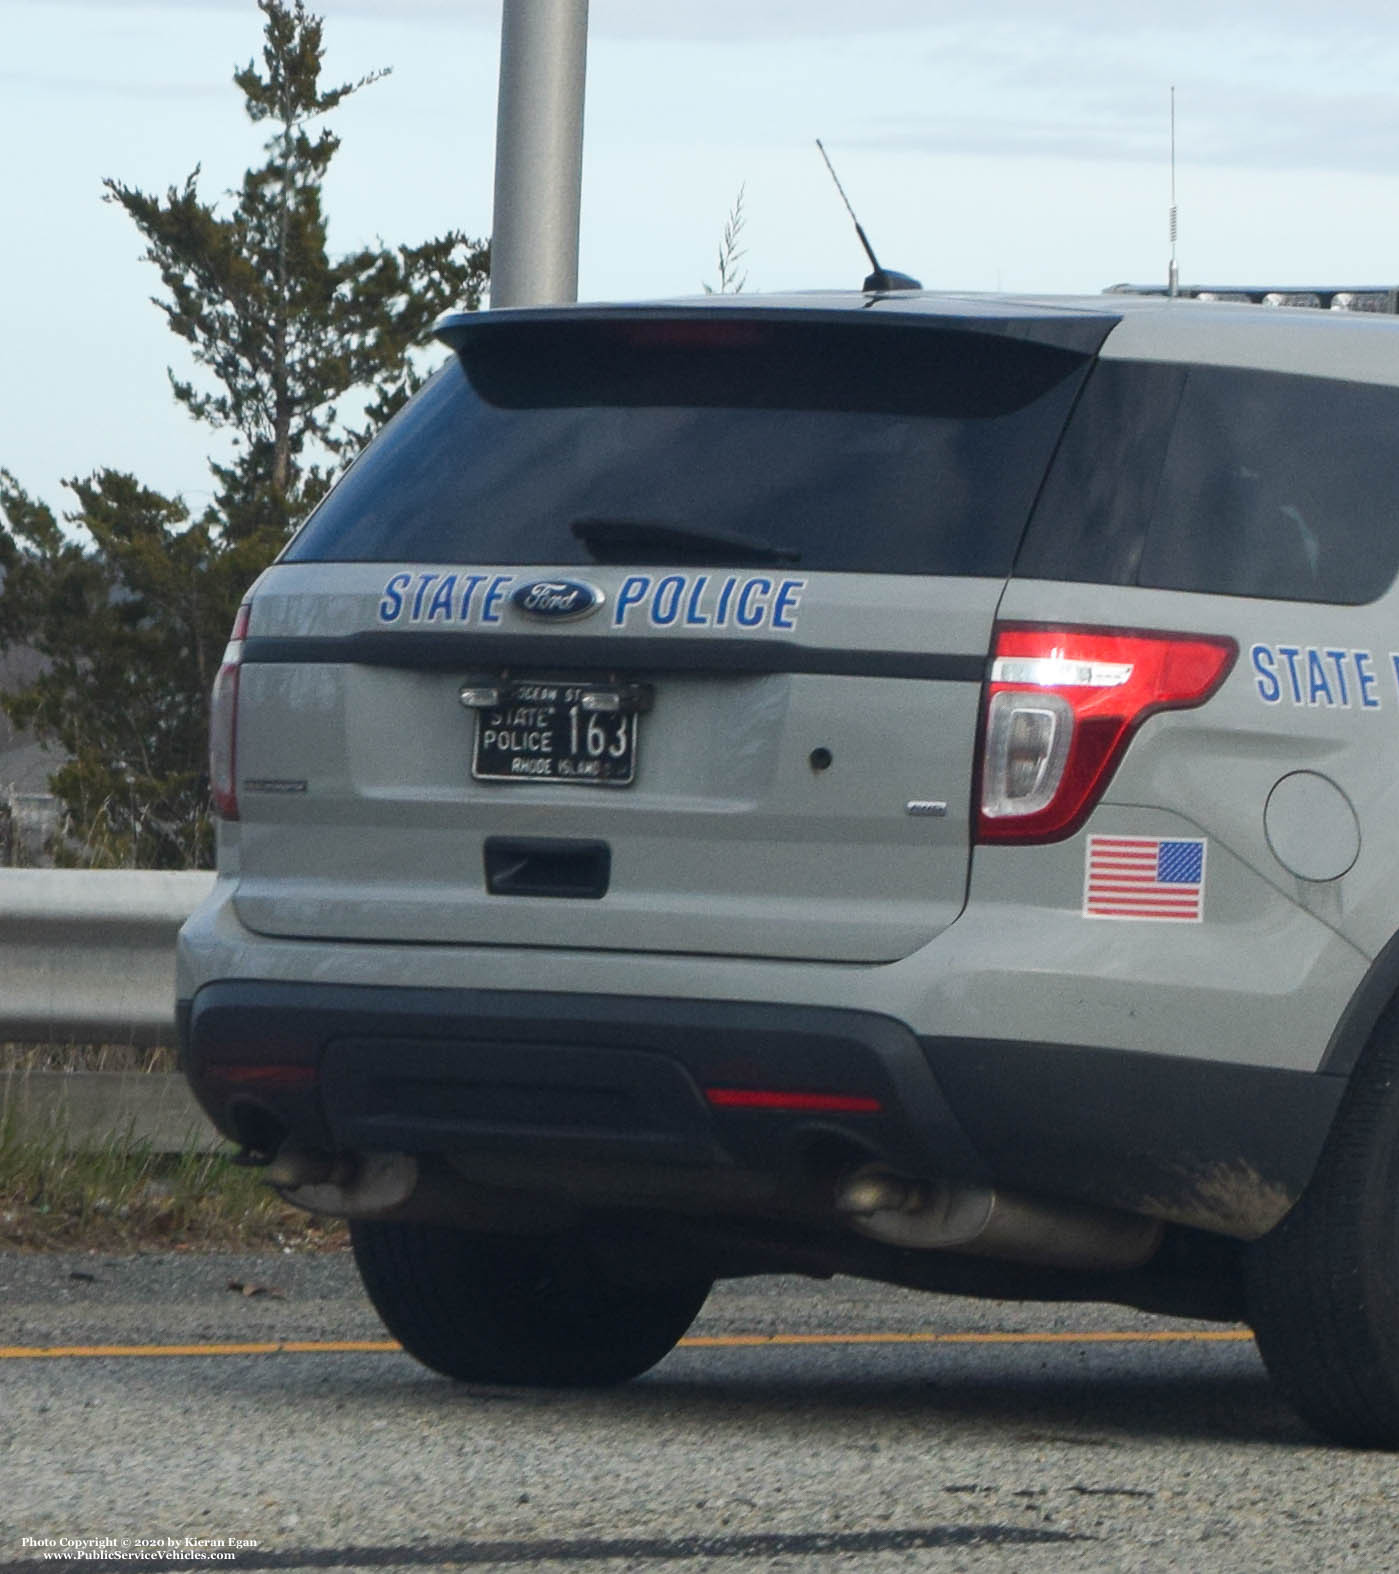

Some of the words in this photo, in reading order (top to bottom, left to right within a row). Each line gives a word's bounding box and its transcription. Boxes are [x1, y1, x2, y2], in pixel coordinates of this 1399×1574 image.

[379, 573, 514, 625] STATE
[611, 574, 804, 632] POLICE
[523, 583, 579, 610] Ford
[1251, 643, 1381, 711] STATE
[483, 730, 553, 752] POLICE
[570, 706, 627, 757] 163
[512, 757, 553, 774] RHODE
